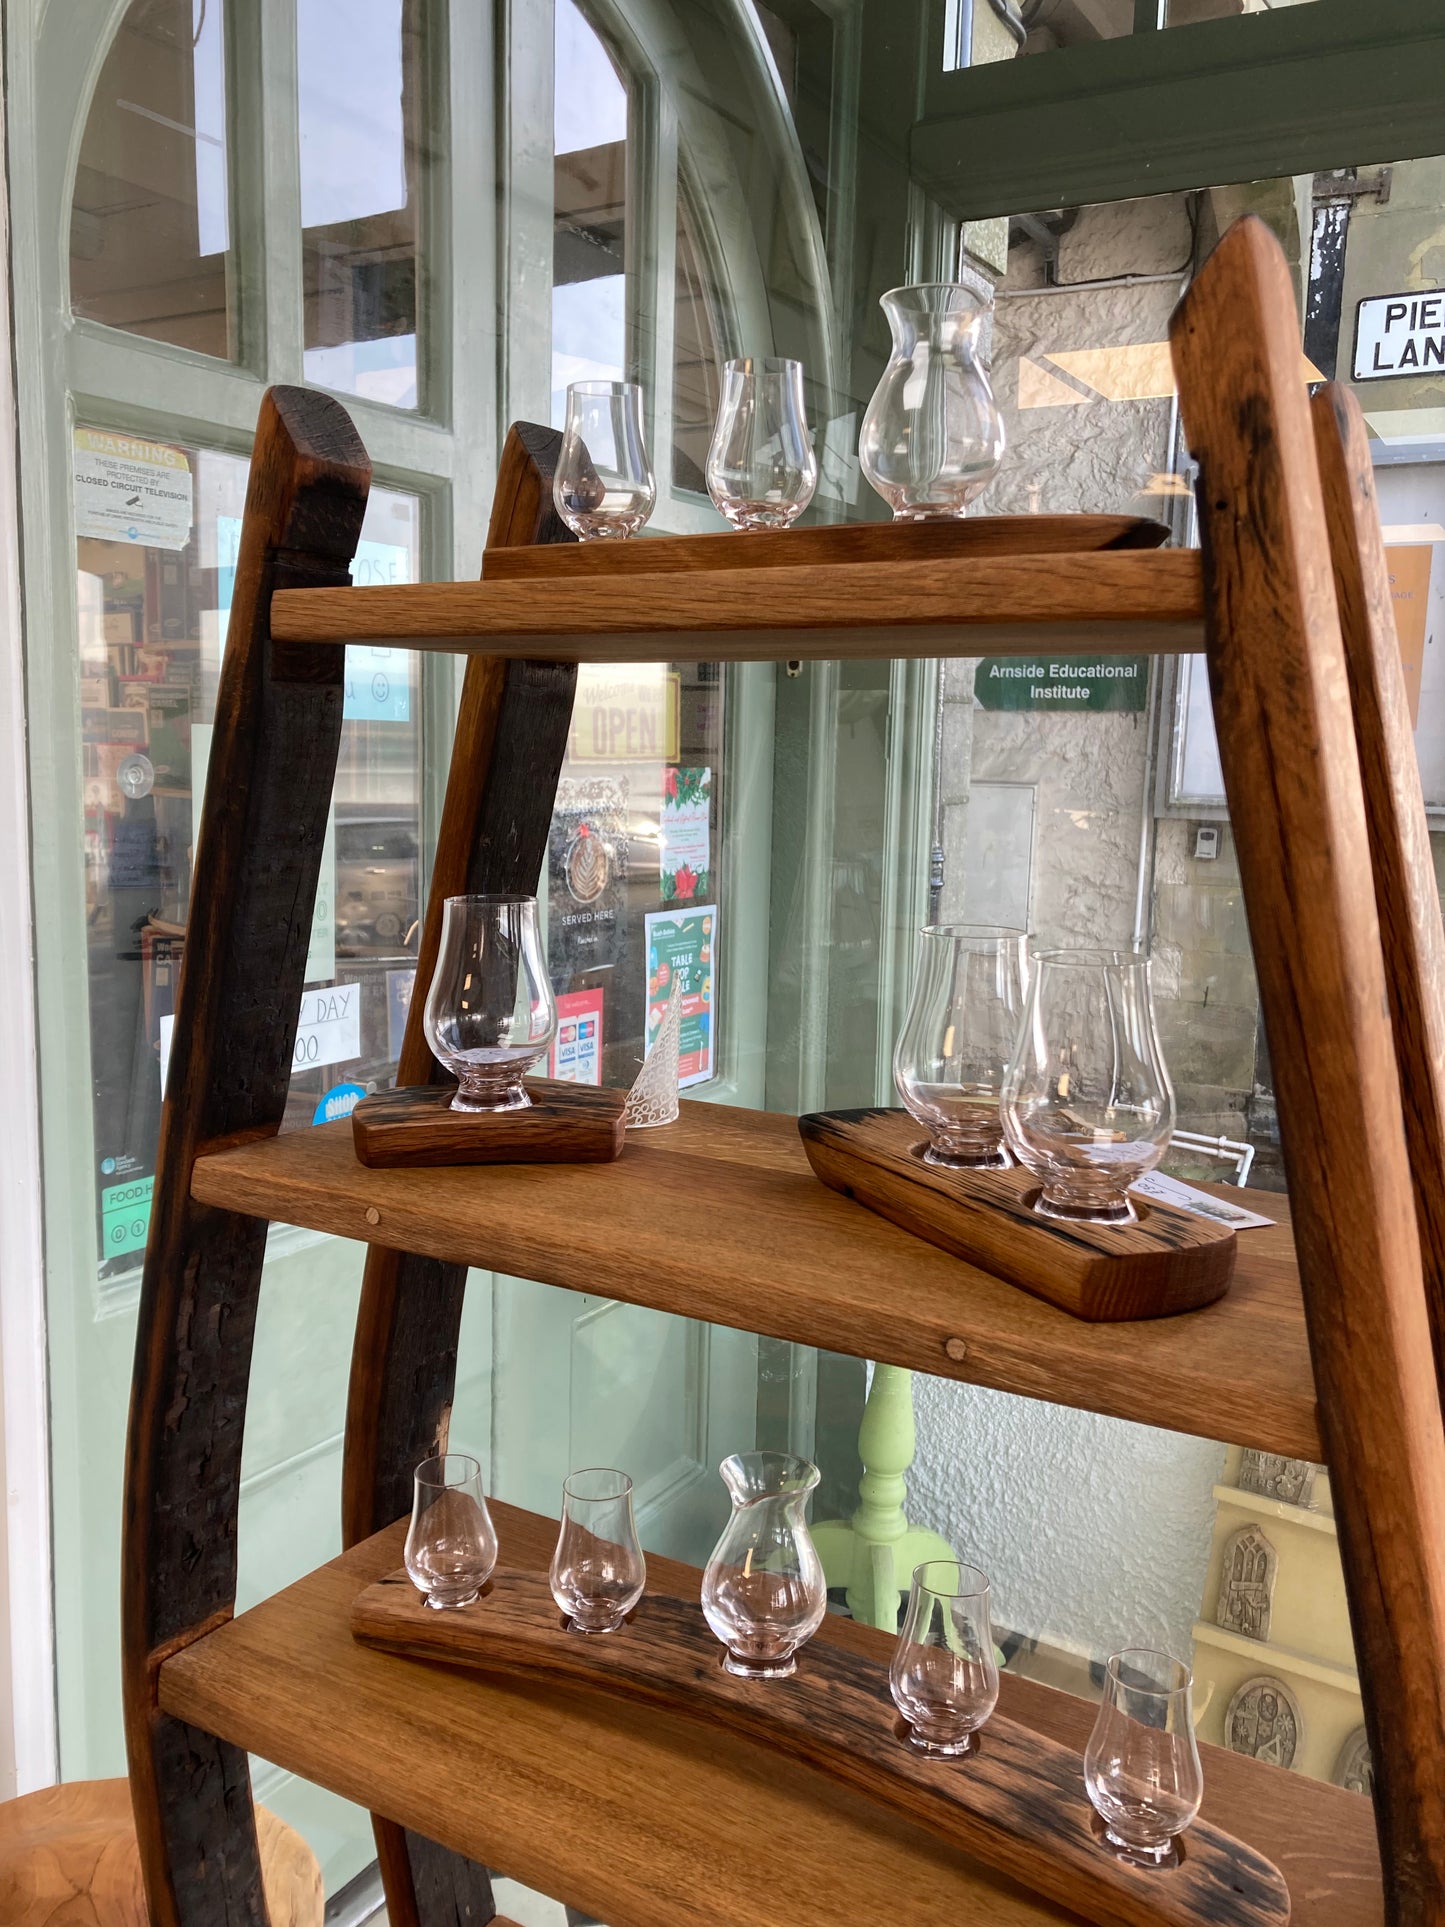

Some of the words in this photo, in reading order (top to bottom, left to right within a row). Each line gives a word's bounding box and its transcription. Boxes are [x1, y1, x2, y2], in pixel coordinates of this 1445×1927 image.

[1385, 299, 1445, 334] PIE
[87, 432, 177, 465] WARNING
[95, 458, 118, 470] THESE
[119, 463, 155, 477] PREMISES
[157, 471, 171, 480] ARE
[106, 470, 149, 485] PROTECTED
[150, 478, 159, 487] BY
[75, 474, 109, 487] CLOSED
[110, 481, 142, 493] CIRCUIT
[145, 487, 188, 502] TELEVISION
[989, 664, 1045, 678] Arnside
[1049, 664, 1137, 678] Educational
[1030, 684, 1090, 699] Institute
[592, 706, 656, 755] OPEN
[561, 913, 593, 926] SERVED
[594, 909, 614, 921] HERE
[671, 953, 693, 967] TABLE
[317, 991, 351, 1023] DAY
[561, 1047, 575, 1057] VISA
[579, 1041, 594, 1052] VISA
[110, 1186, 143, 1205] FOOD
[1243, 1472, 1274, 1490] HERE
